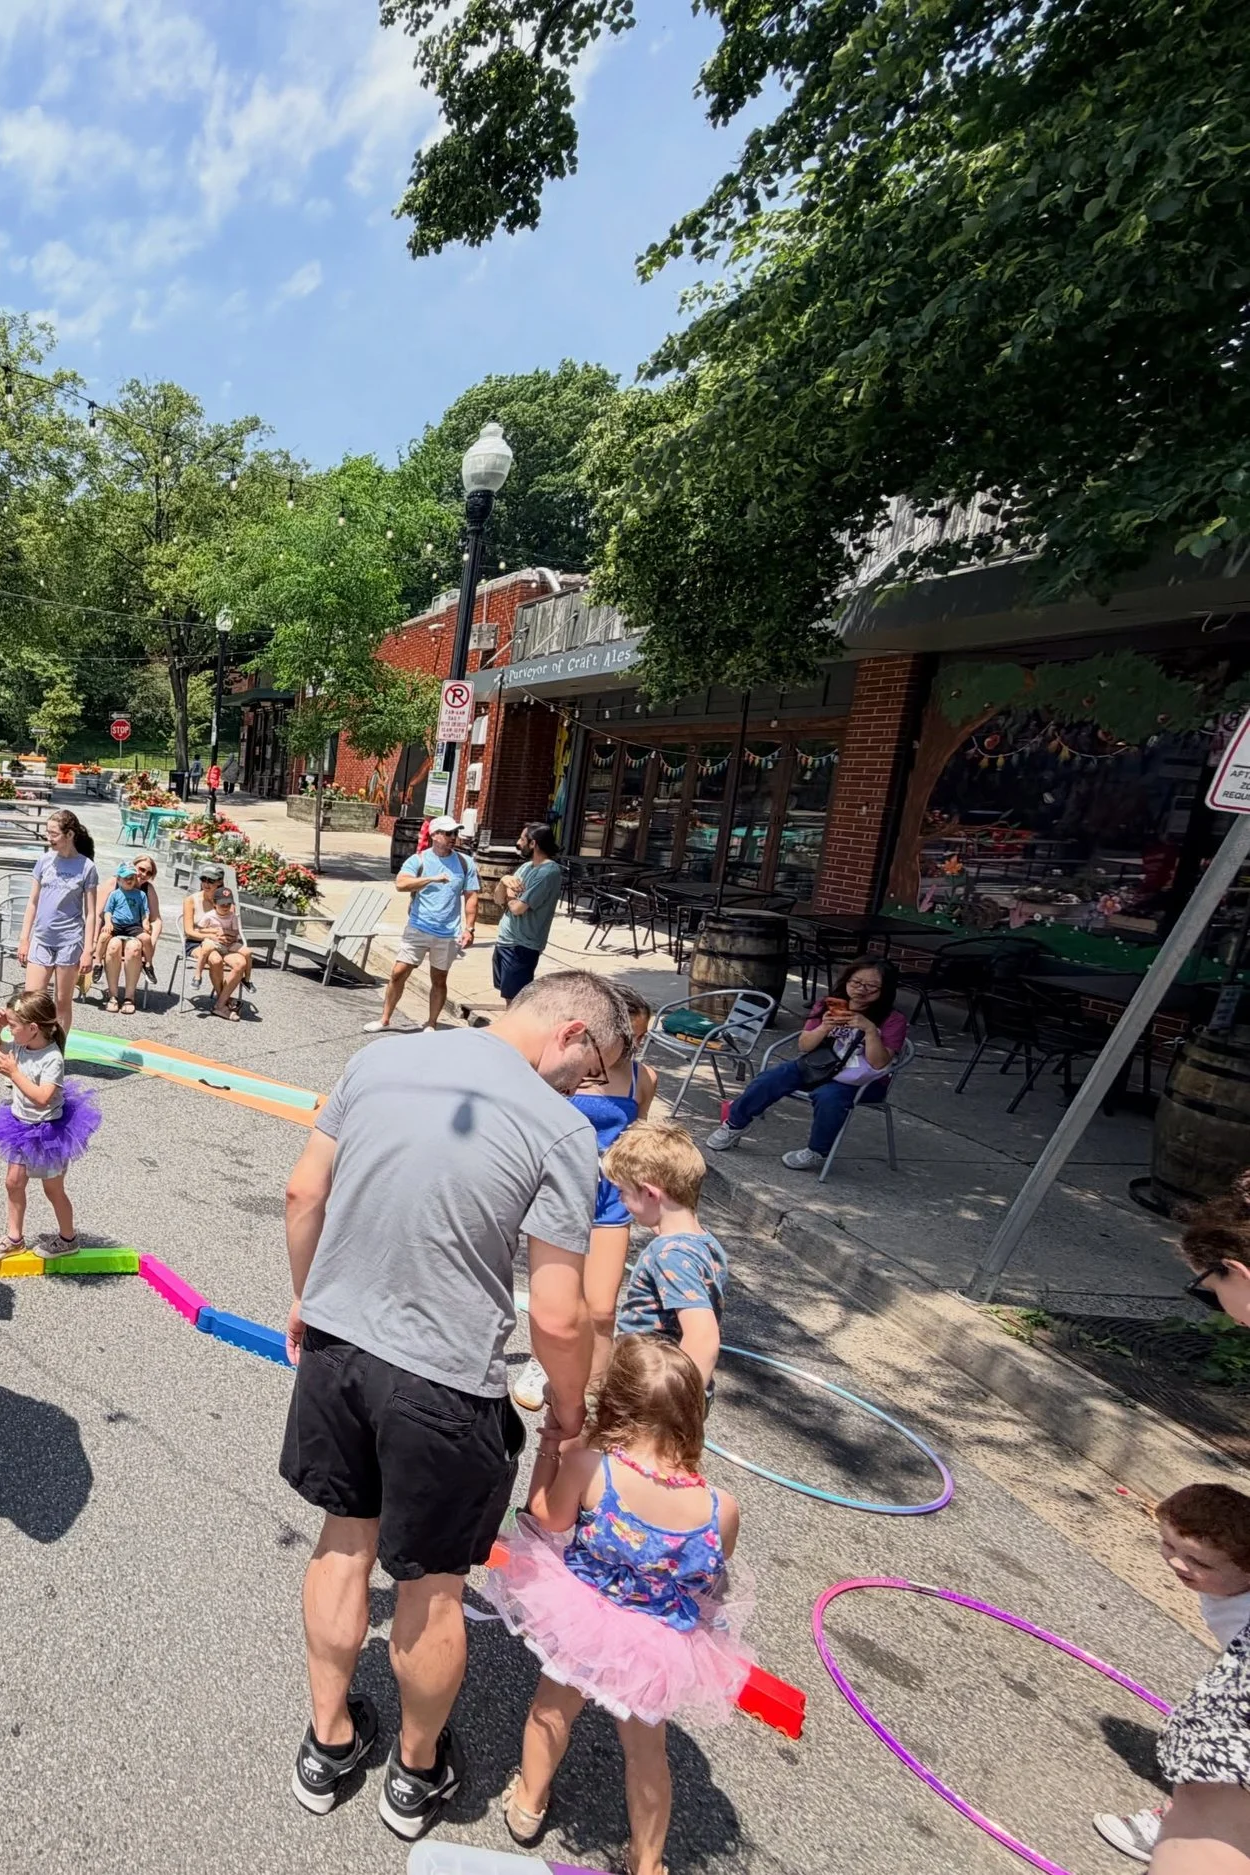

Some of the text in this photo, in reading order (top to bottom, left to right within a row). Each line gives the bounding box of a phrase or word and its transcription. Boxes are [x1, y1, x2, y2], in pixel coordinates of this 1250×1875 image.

[509, 664, 548, 683] Purveyor
[552, 659, 565, 674] of
[567, 653, 598, 672] Craft
[603, 649, 631, 668] Ales
[113, 726, 129, 734] STOP
[1230, 770, 1250, 780] AFT
